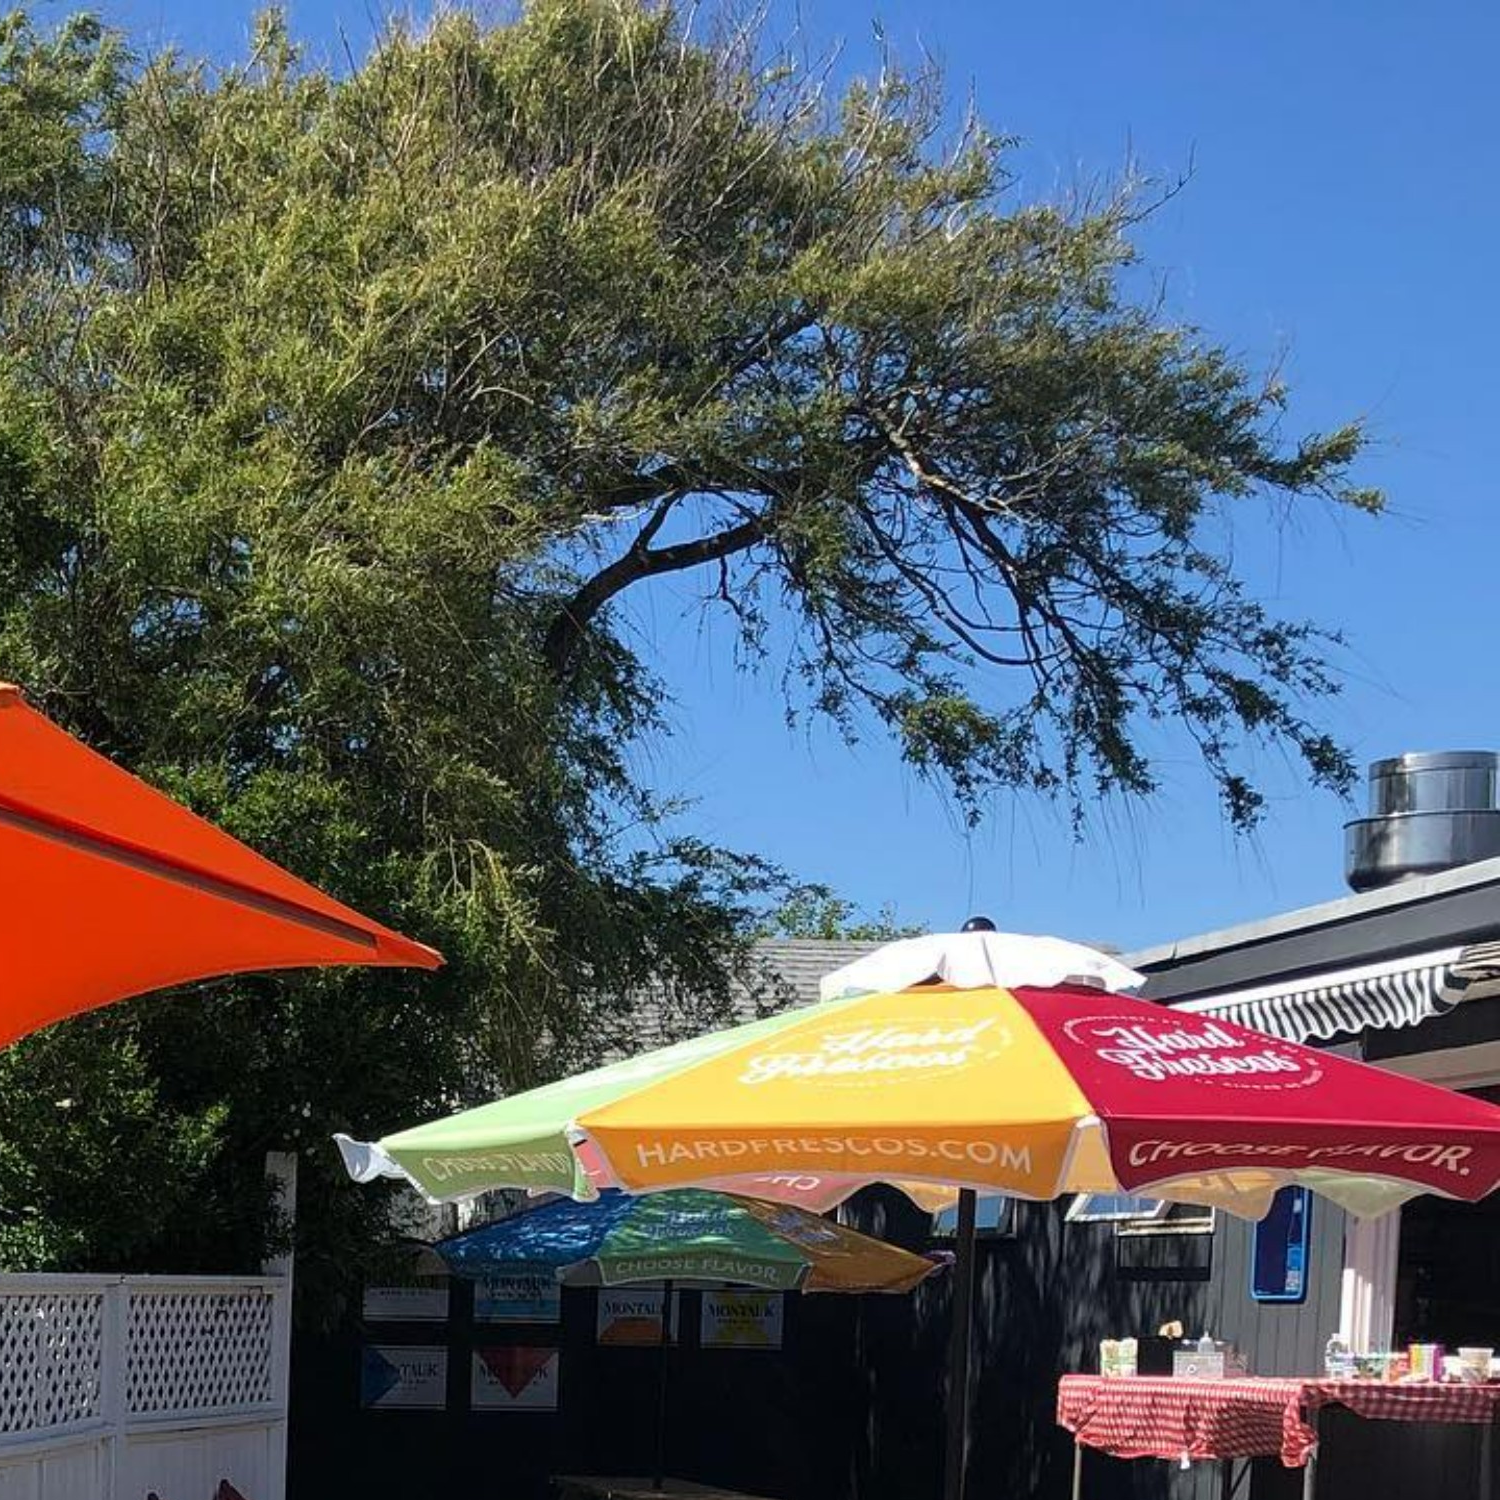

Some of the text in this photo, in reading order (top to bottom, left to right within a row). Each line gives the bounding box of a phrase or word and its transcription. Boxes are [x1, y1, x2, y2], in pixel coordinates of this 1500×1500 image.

[1091, 1023, 1245, 1055] Hard
[1097, 1050, 1301, 1081] Frescos
[637, 1136, 1032, 1174] HARDFRESCOS.COM
[615, 1259, 696, 1274] CHOOSE
[603, 1300, 663, 1316] MONTAU
[707, 1302, 776, 1319] MONTAUK
